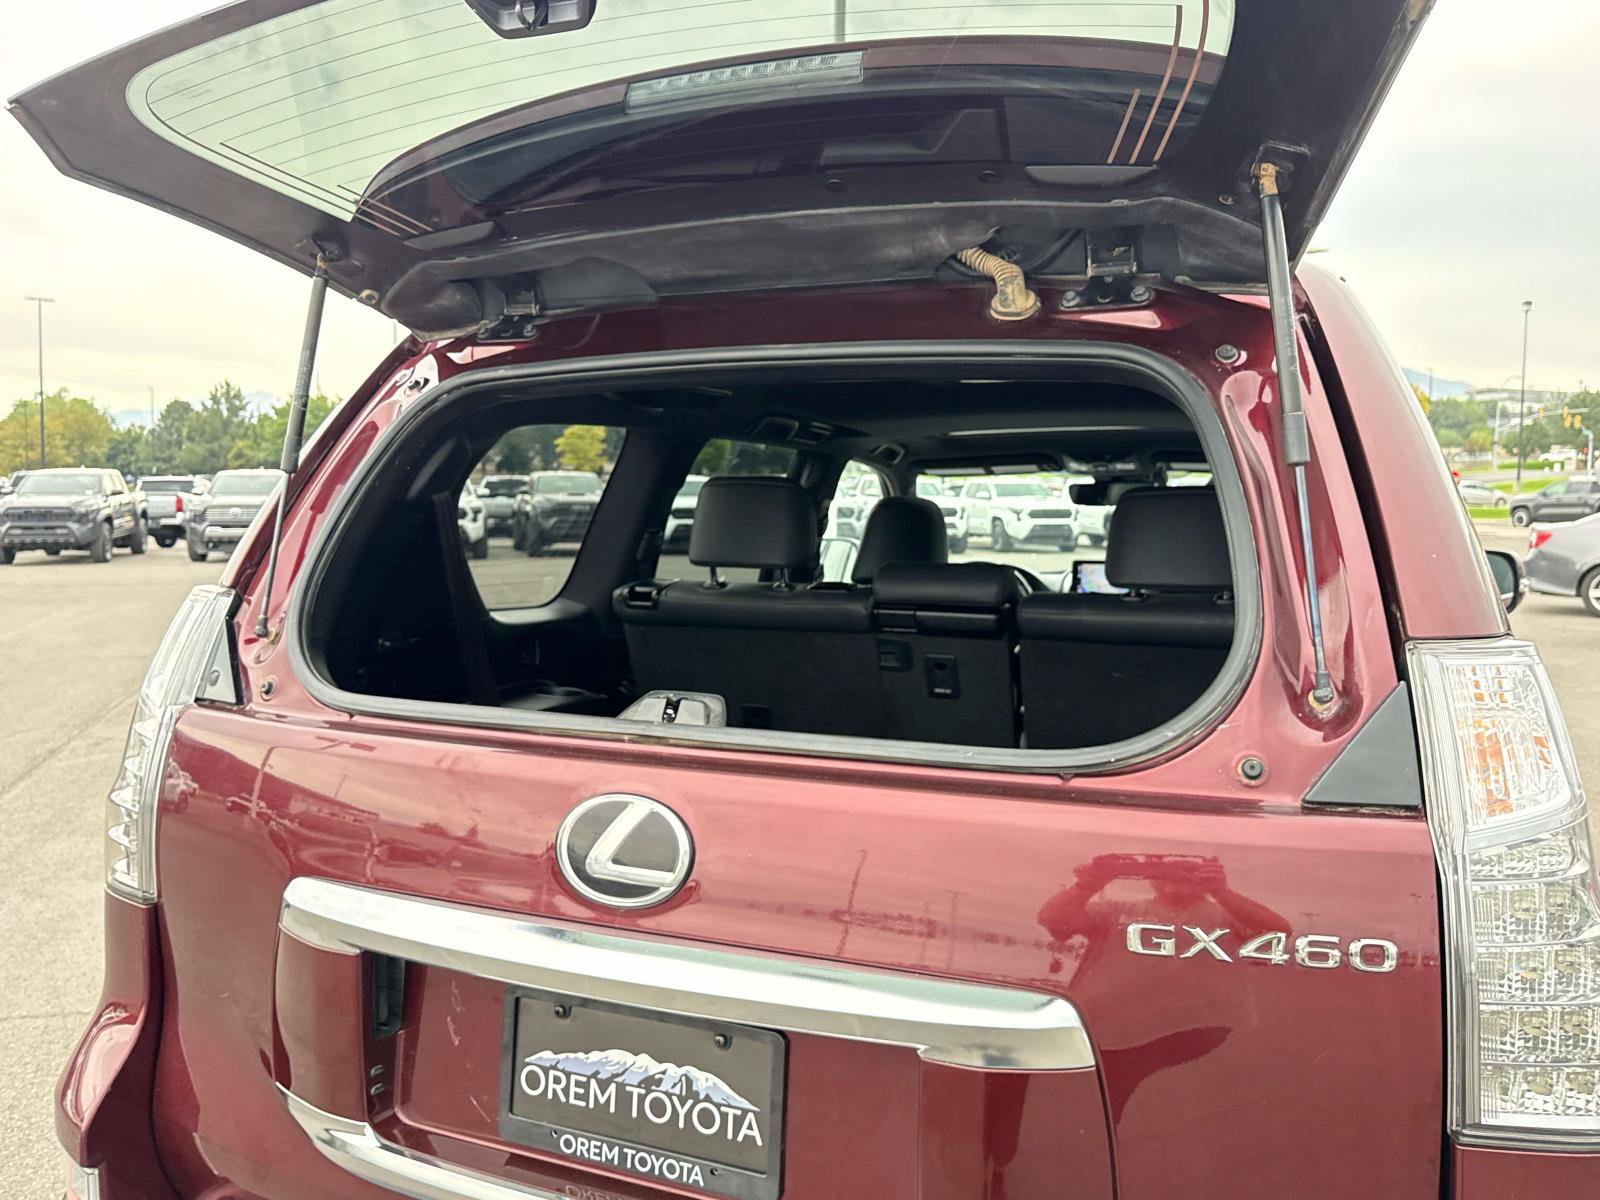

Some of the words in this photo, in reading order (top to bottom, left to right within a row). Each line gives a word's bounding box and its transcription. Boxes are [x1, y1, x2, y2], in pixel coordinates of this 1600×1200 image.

[520, 1064, 617, 1114] OREM
[624, 1085, 763, 1146] TOYOTA
[559, 1133, 619, 1166] OREM
[623, 1149, 705, 1187] TOYOTA
